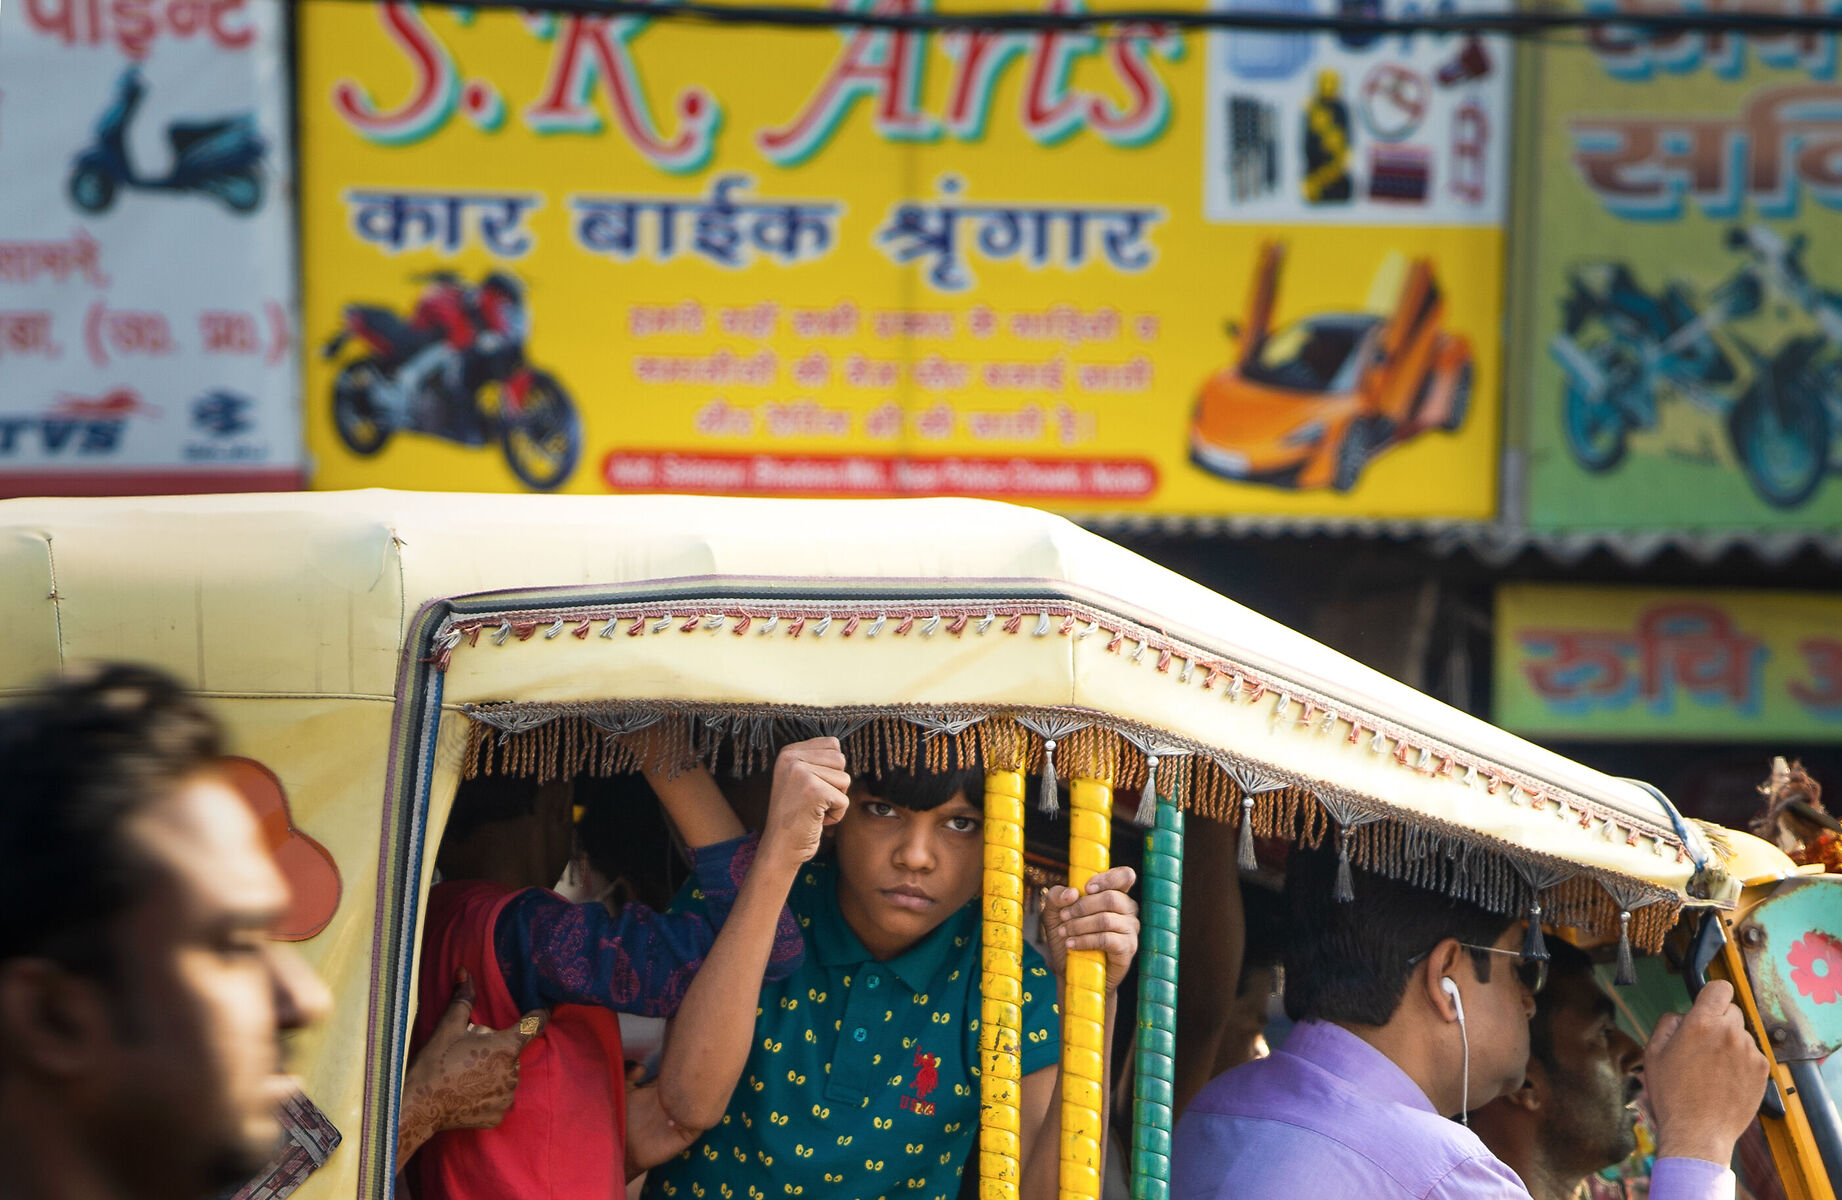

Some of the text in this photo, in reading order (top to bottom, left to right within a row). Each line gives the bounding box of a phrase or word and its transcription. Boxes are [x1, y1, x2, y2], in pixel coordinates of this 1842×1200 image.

[342, 186, 550, 258] कार
[564, 172, 848, 270] बाईक
[0, 416, 129, 457] TVS
